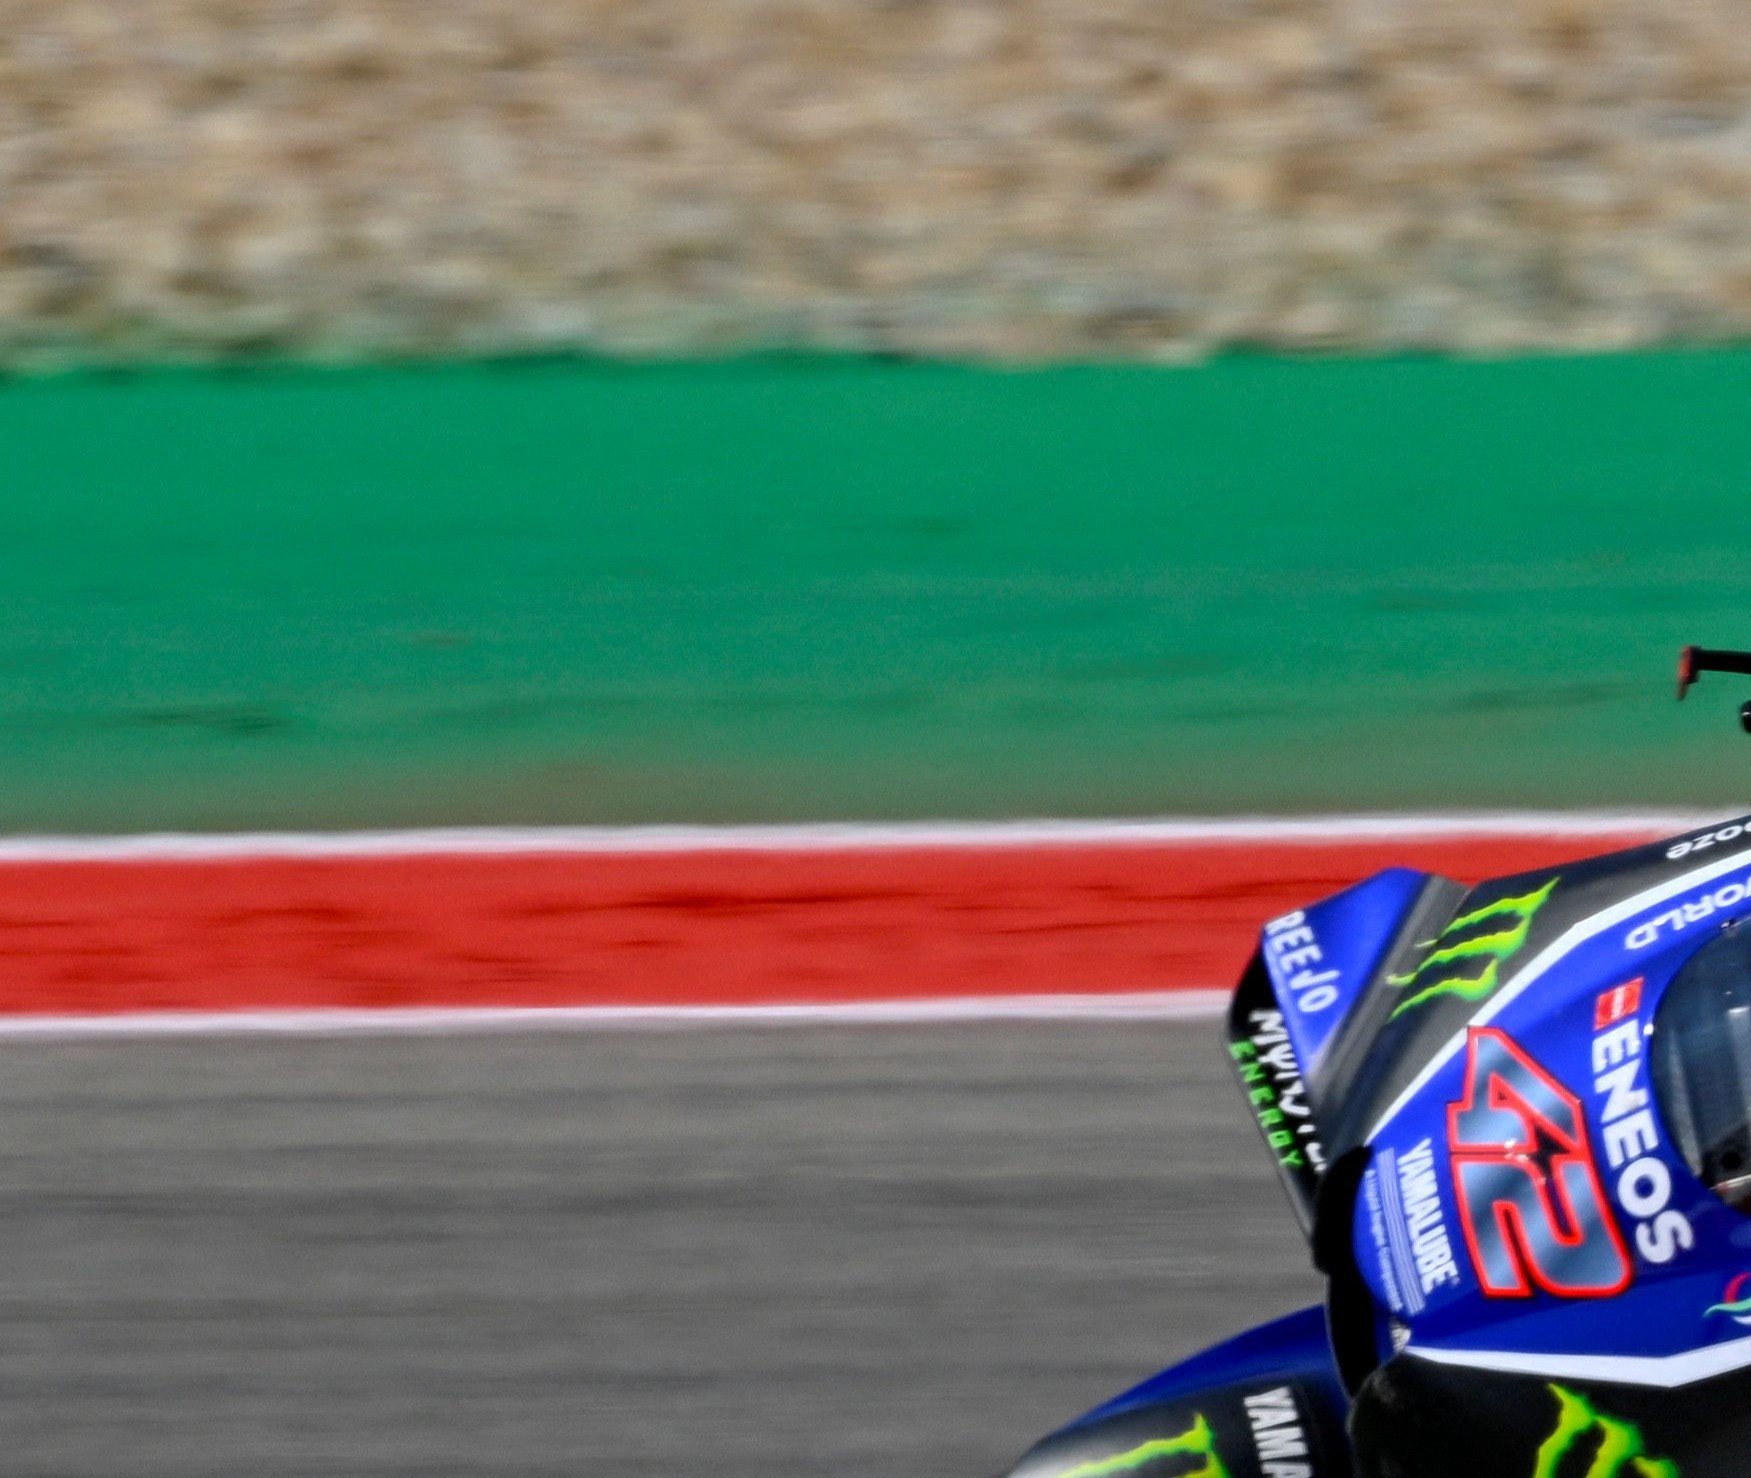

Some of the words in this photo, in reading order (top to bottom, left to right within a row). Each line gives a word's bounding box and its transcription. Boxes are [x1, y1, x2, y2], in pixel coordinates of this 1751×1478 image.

[1228, 1038, 1304, 1167] ENERGY
[1446, 1025, 1636, 1298] 42
[1592, 1021, 1695, 1264] ENEOS
[1396, 1137, 1460, 1295] YAMALUBE
